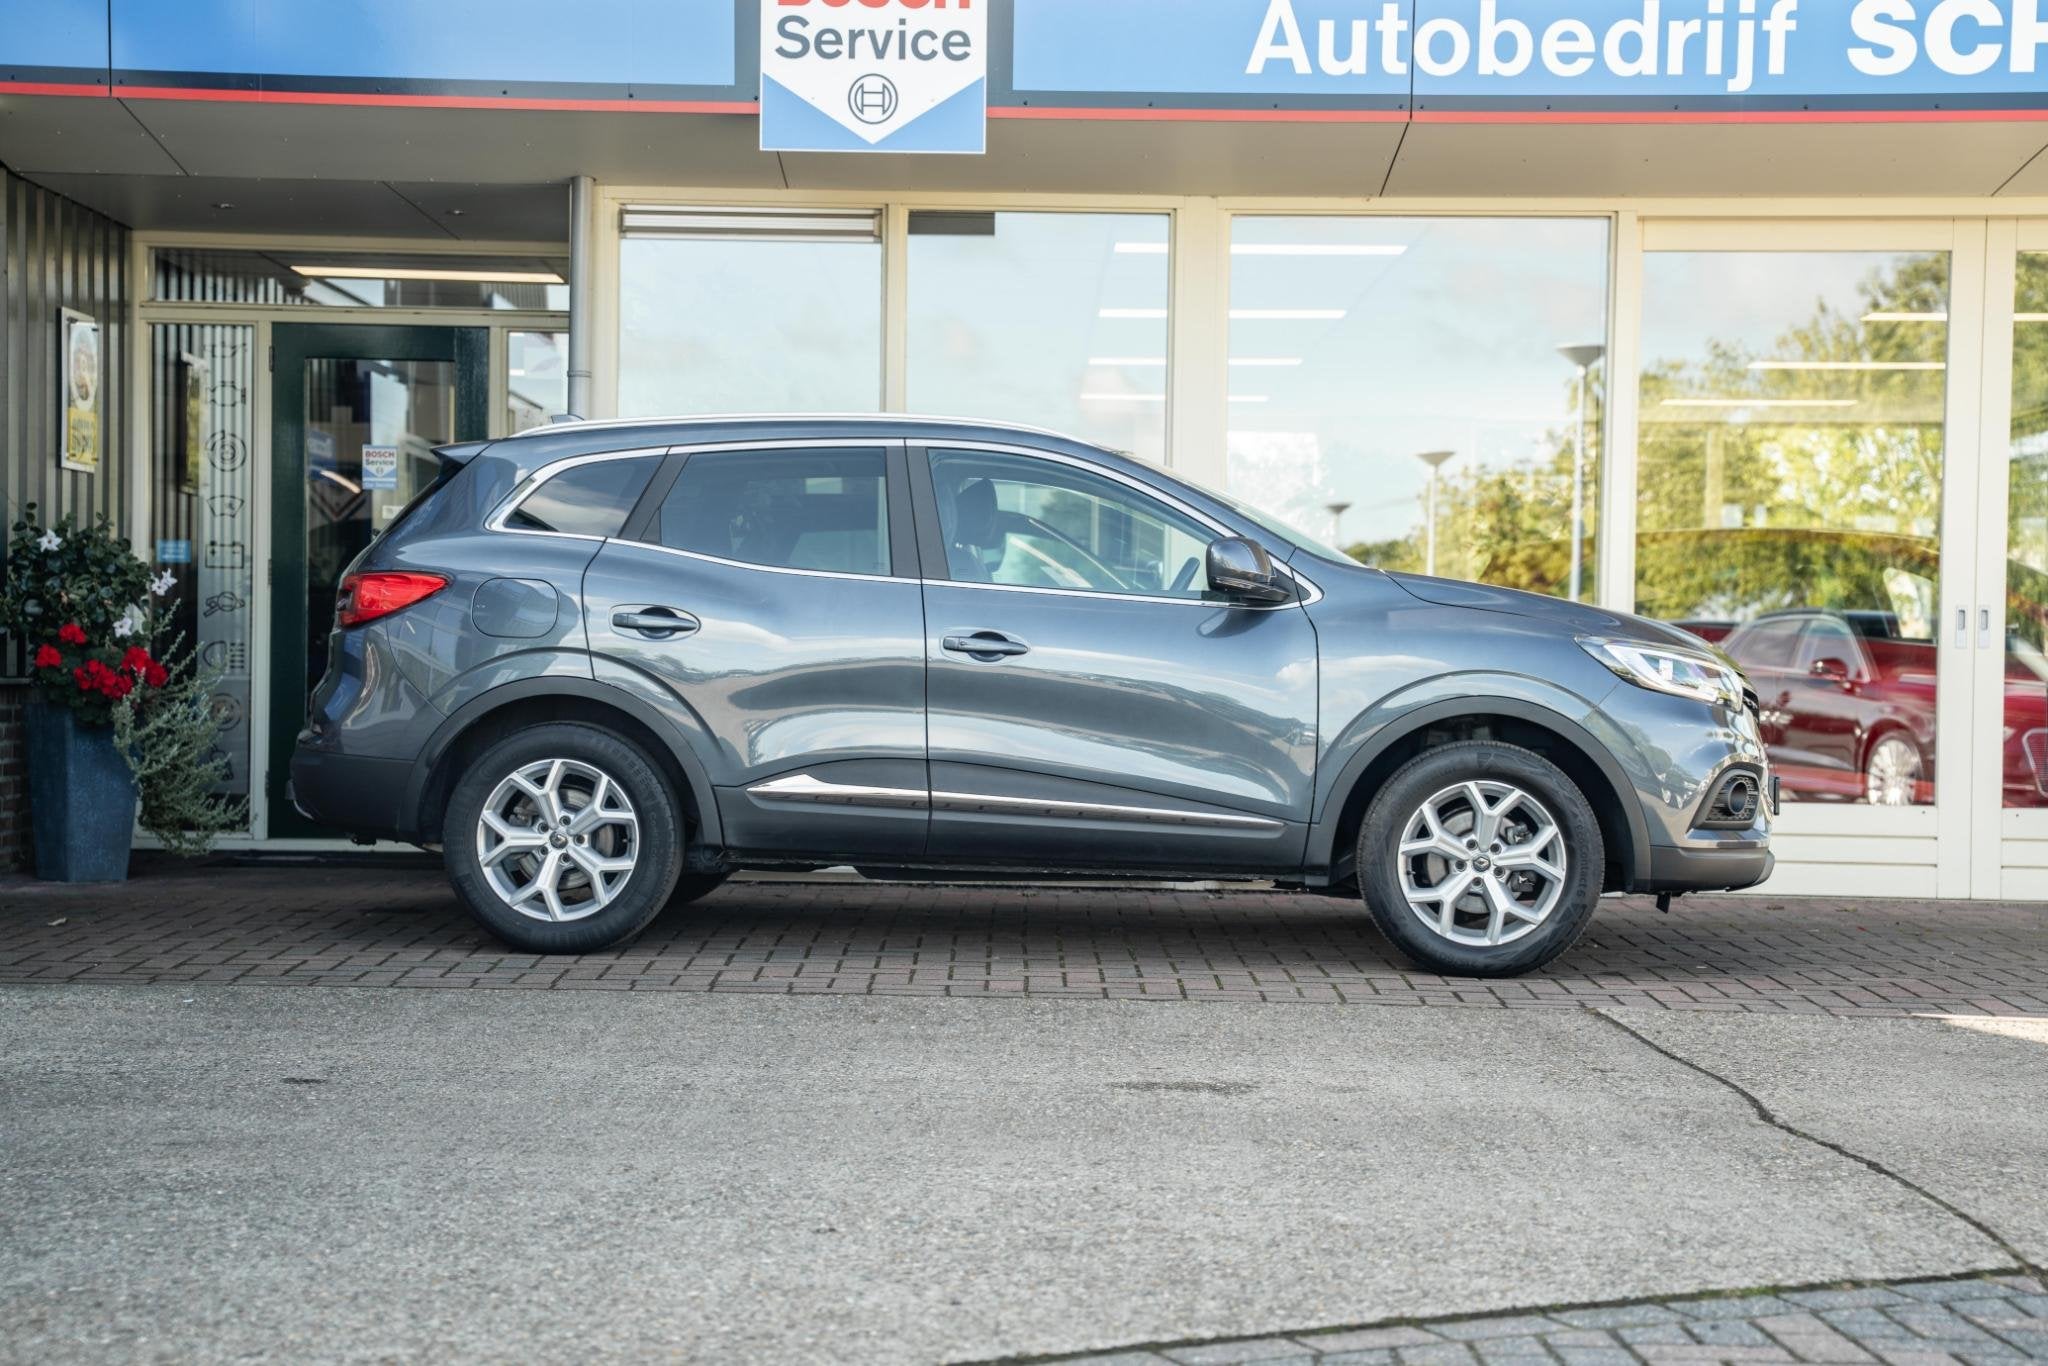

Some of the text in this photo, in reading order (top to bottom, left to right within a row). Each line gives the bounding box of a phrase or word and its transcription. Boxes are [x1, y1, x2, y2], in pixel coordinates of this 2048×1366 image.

[775, 15, 971, 61] Service
[1245, 0, 1797, 92] Autobedrijf
[365, 450, 395, 458] BOSCH
[365, 458, 395, 466] Service
